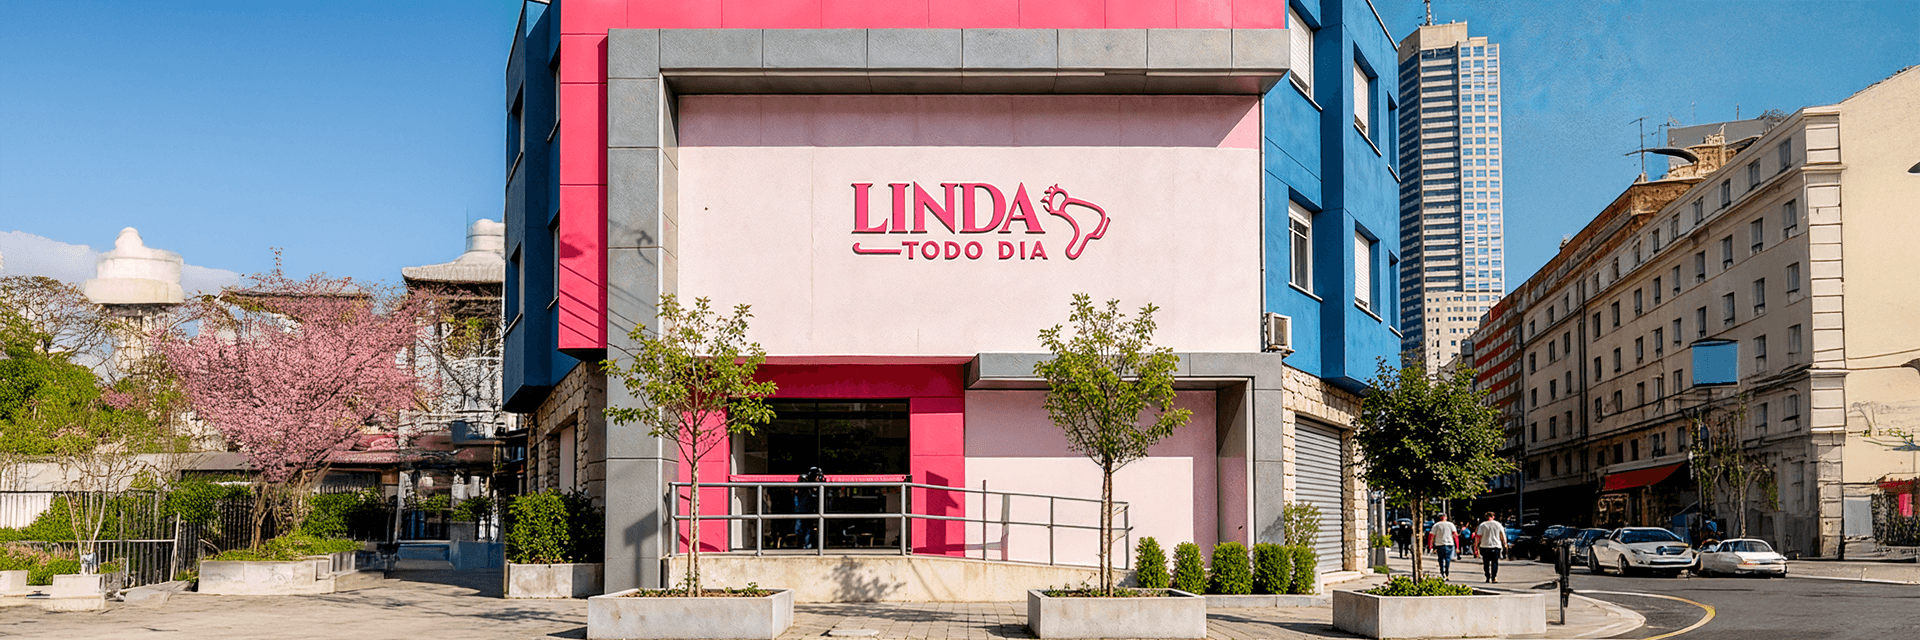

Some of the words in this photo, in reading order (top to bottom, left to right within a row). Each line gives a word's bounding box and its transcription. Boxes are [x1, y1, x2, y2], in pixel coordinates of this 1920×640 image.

[851, 181, 1046, 235] LINDA
[902, 241, 984, 260] TODO
[998, 241, 1049, 260] DIA
